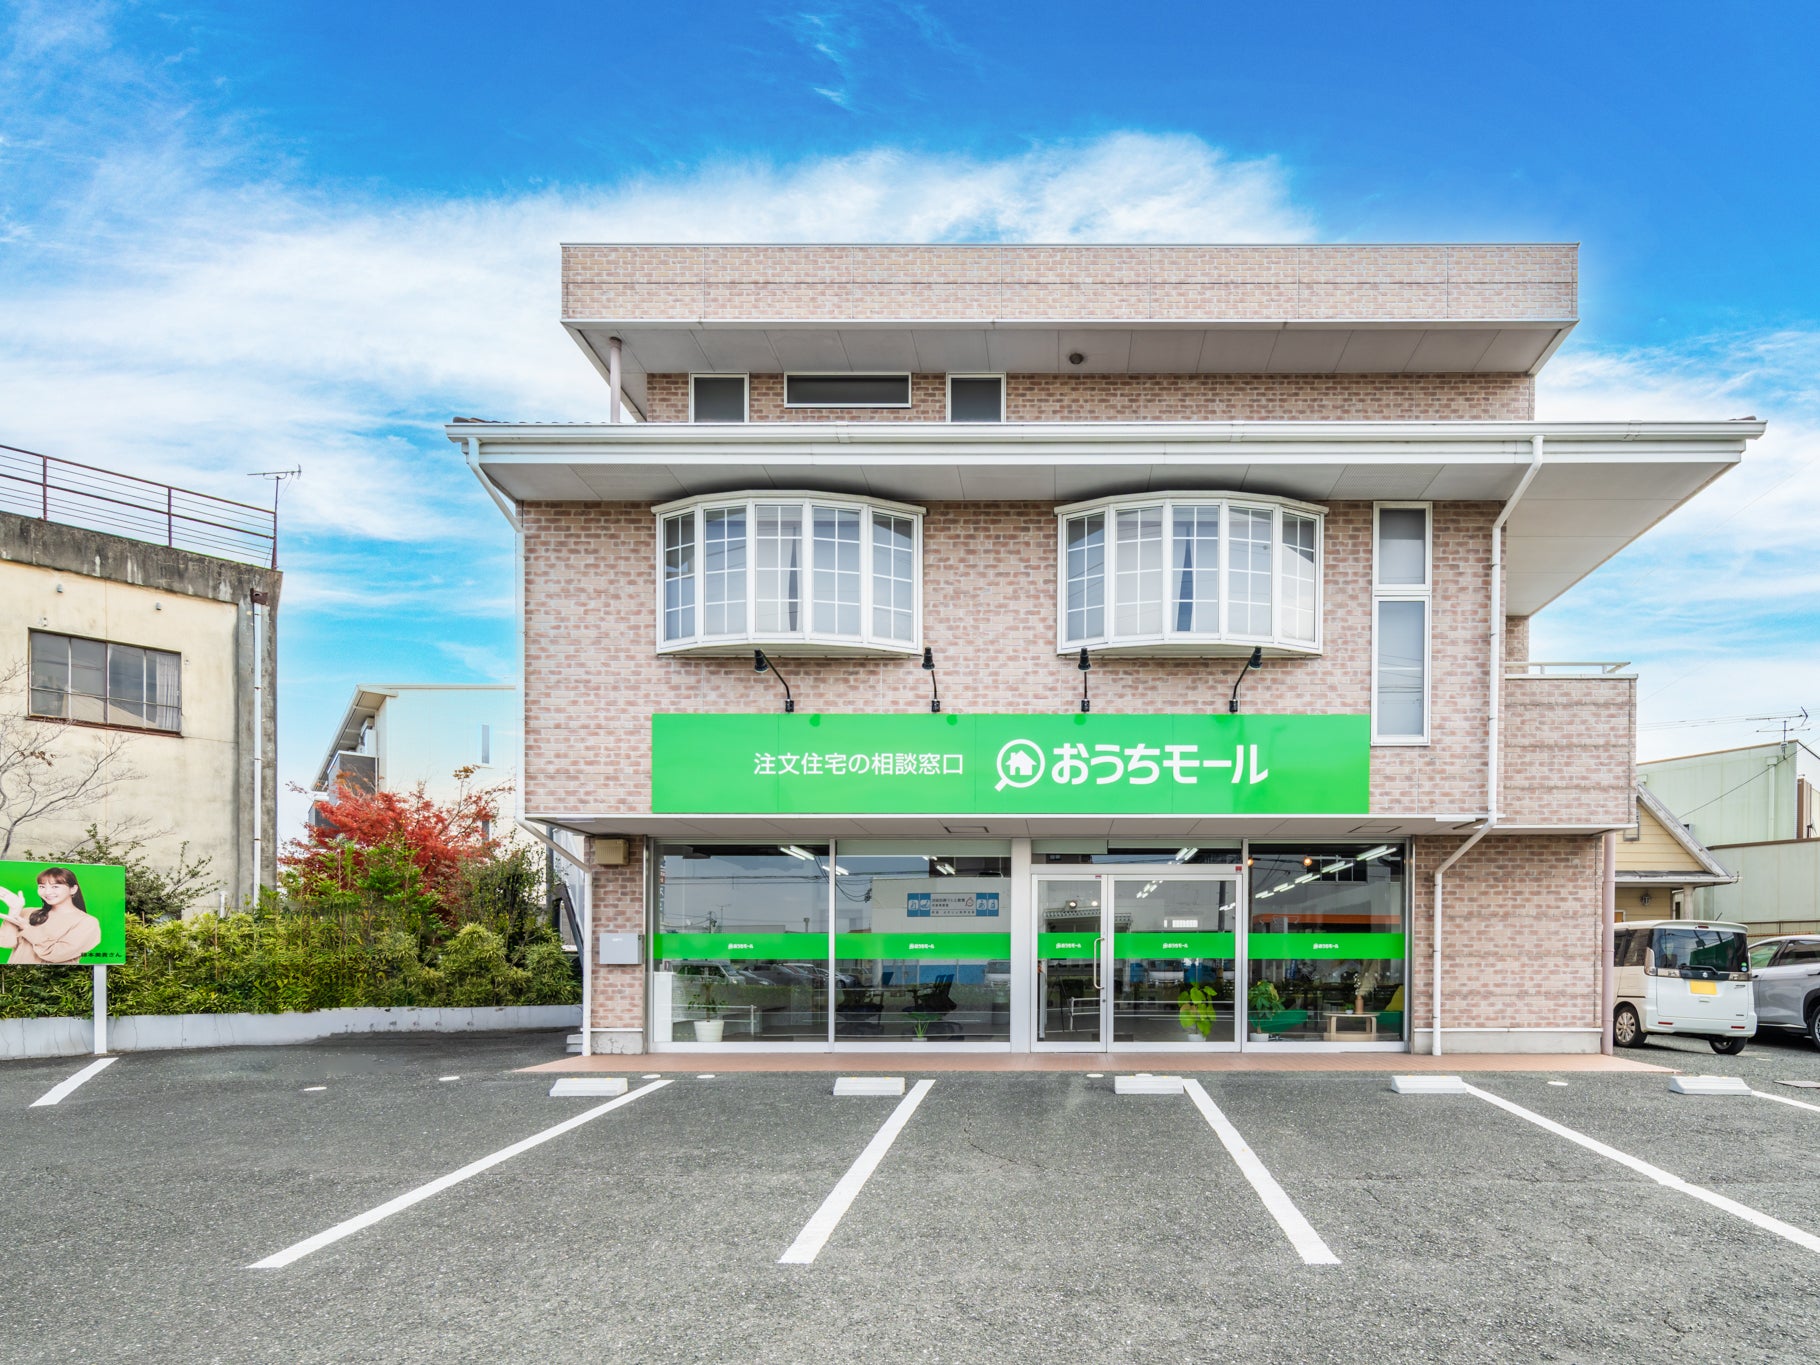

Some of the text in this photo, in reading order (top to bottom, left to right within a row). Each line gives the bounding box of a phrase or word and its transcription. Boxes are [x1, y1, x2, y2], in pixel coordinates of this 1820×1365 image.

[753, 752, 964, 775] 注文住宅の相談窓口
[1051, 743, 1269, 785] おうちモール
